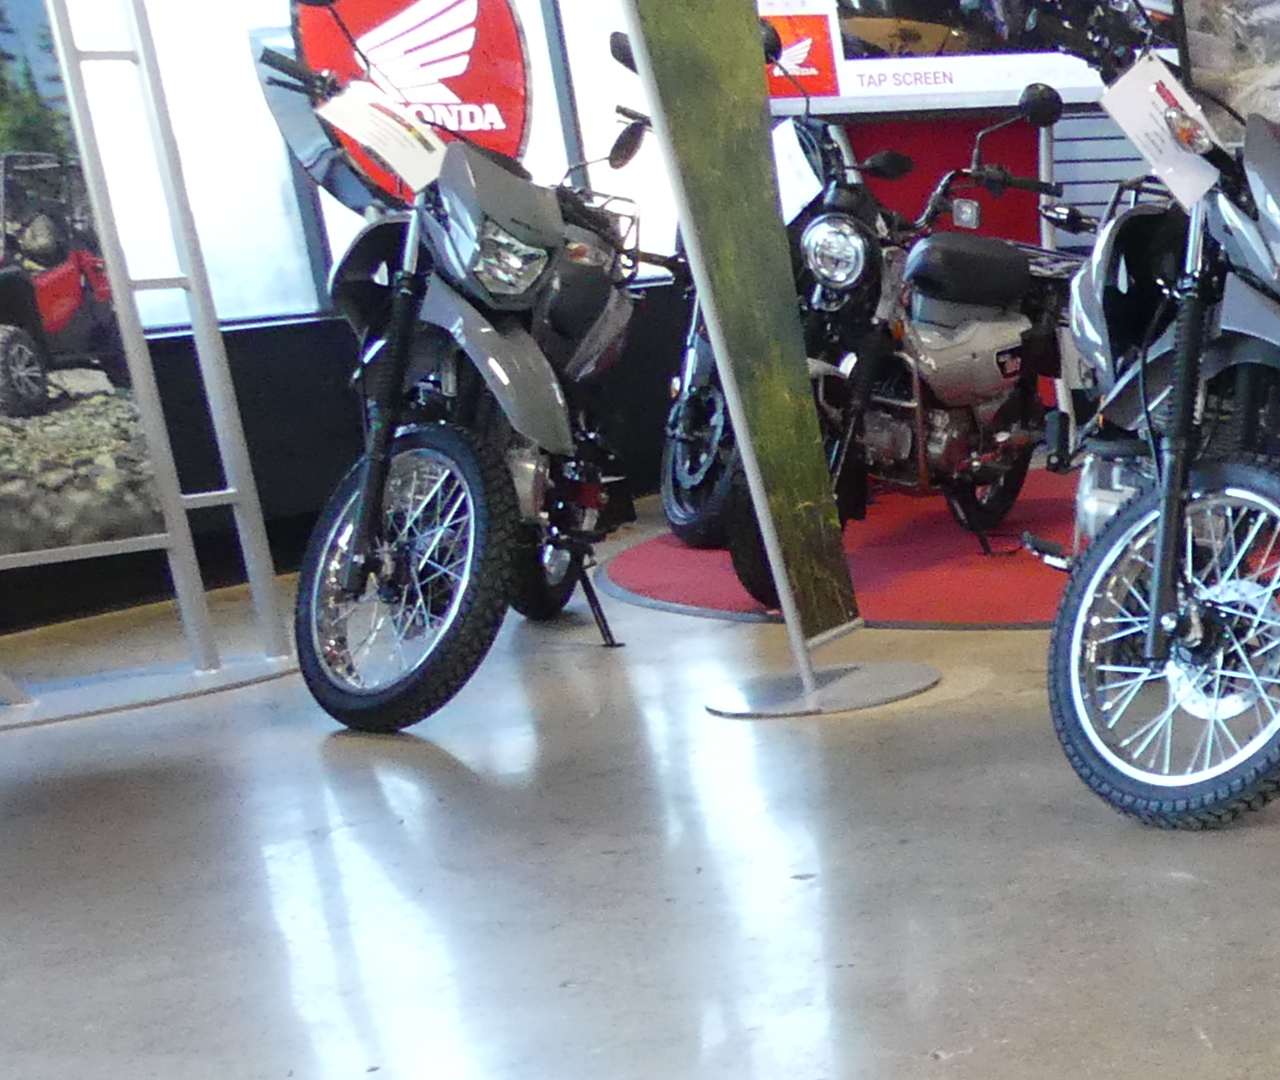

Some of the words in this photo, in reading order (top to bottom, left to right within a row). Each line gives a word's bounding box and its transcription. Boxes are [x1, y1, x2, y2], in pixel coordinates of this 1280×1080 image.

[857, 73, 888, 87] TAP
[892, 71, 954, 87] SCREEN
[407, 103, 506, 131] ONDA
